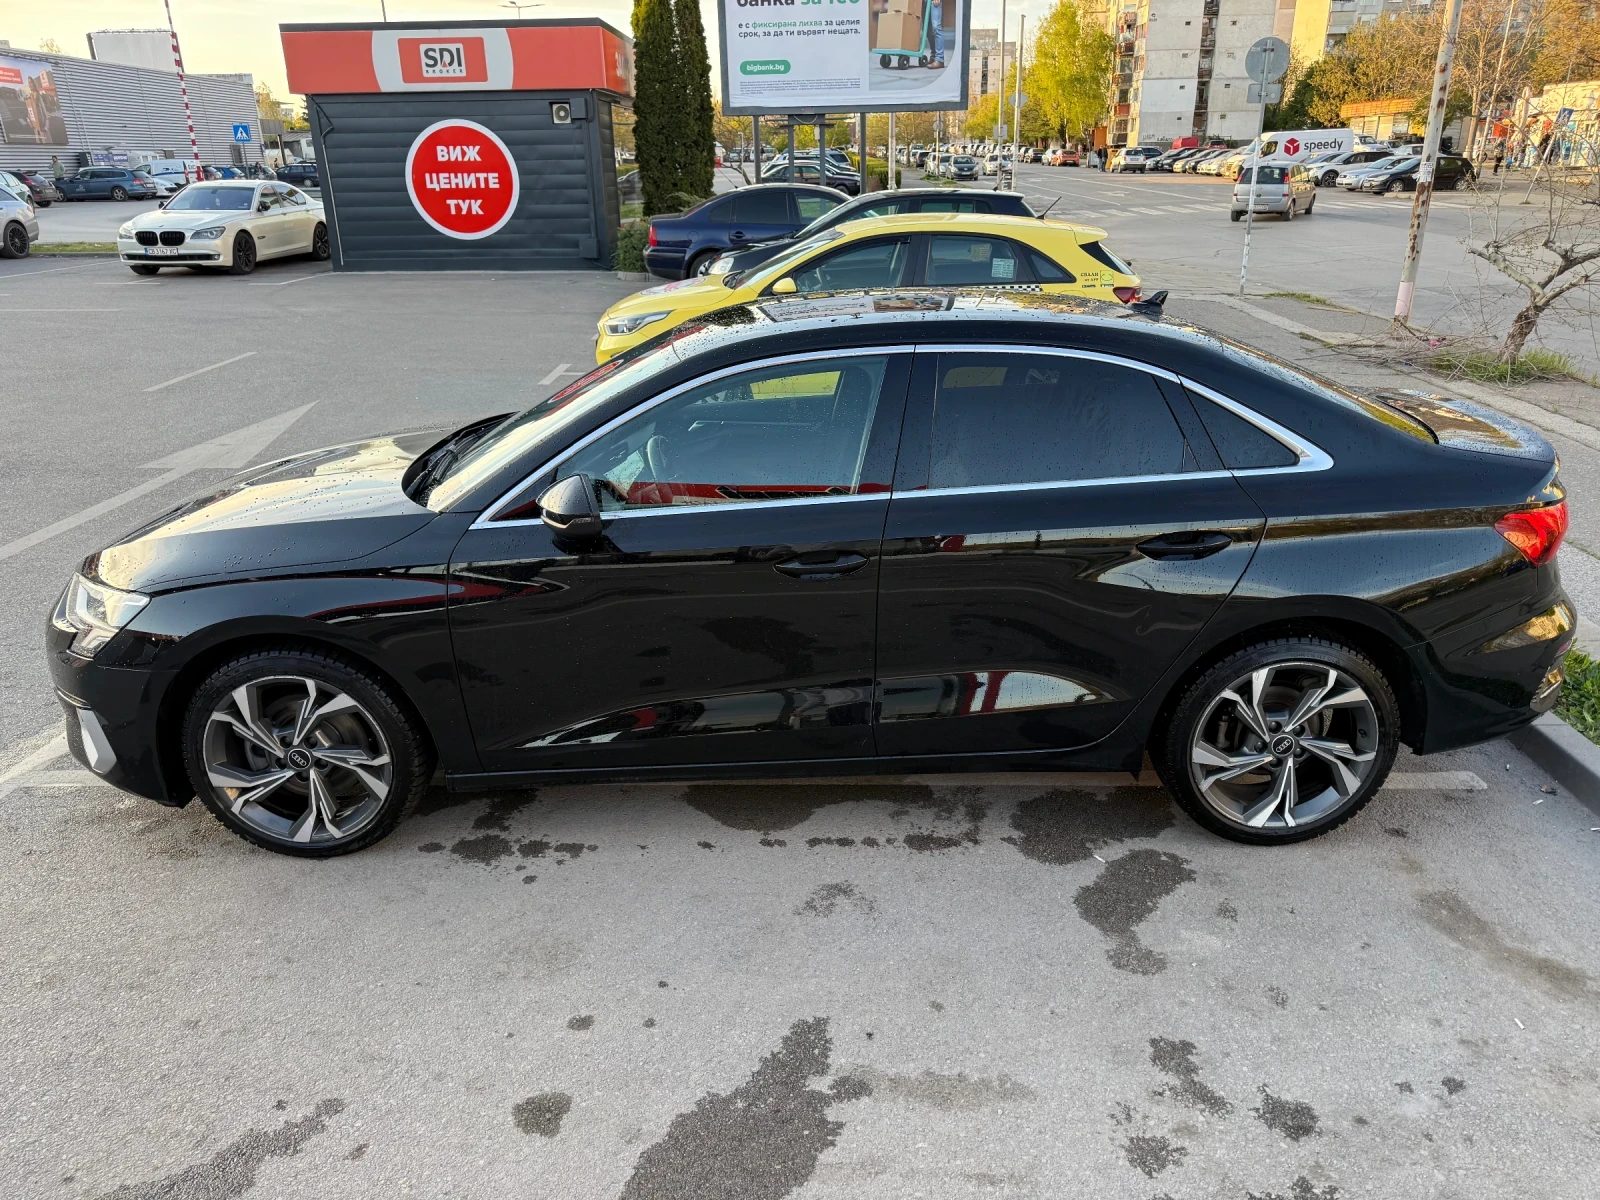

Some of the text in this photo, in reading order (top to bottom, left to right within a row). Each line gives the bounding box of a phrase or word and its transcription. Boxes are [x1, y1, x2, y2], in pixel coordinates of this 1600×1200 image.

[751, 21, 797, 30] фиксирана
[423, 47, 463, 68] SDI
[746, 64, 785, 72] bigbank.bg
[1303, 138, 1344, 152] speedy
[436, 145, 483, 162] ВИЖ
[424, 172, 500, 192] ЦЕНИТЕ
[446, 199, 485, 215] ТУК
